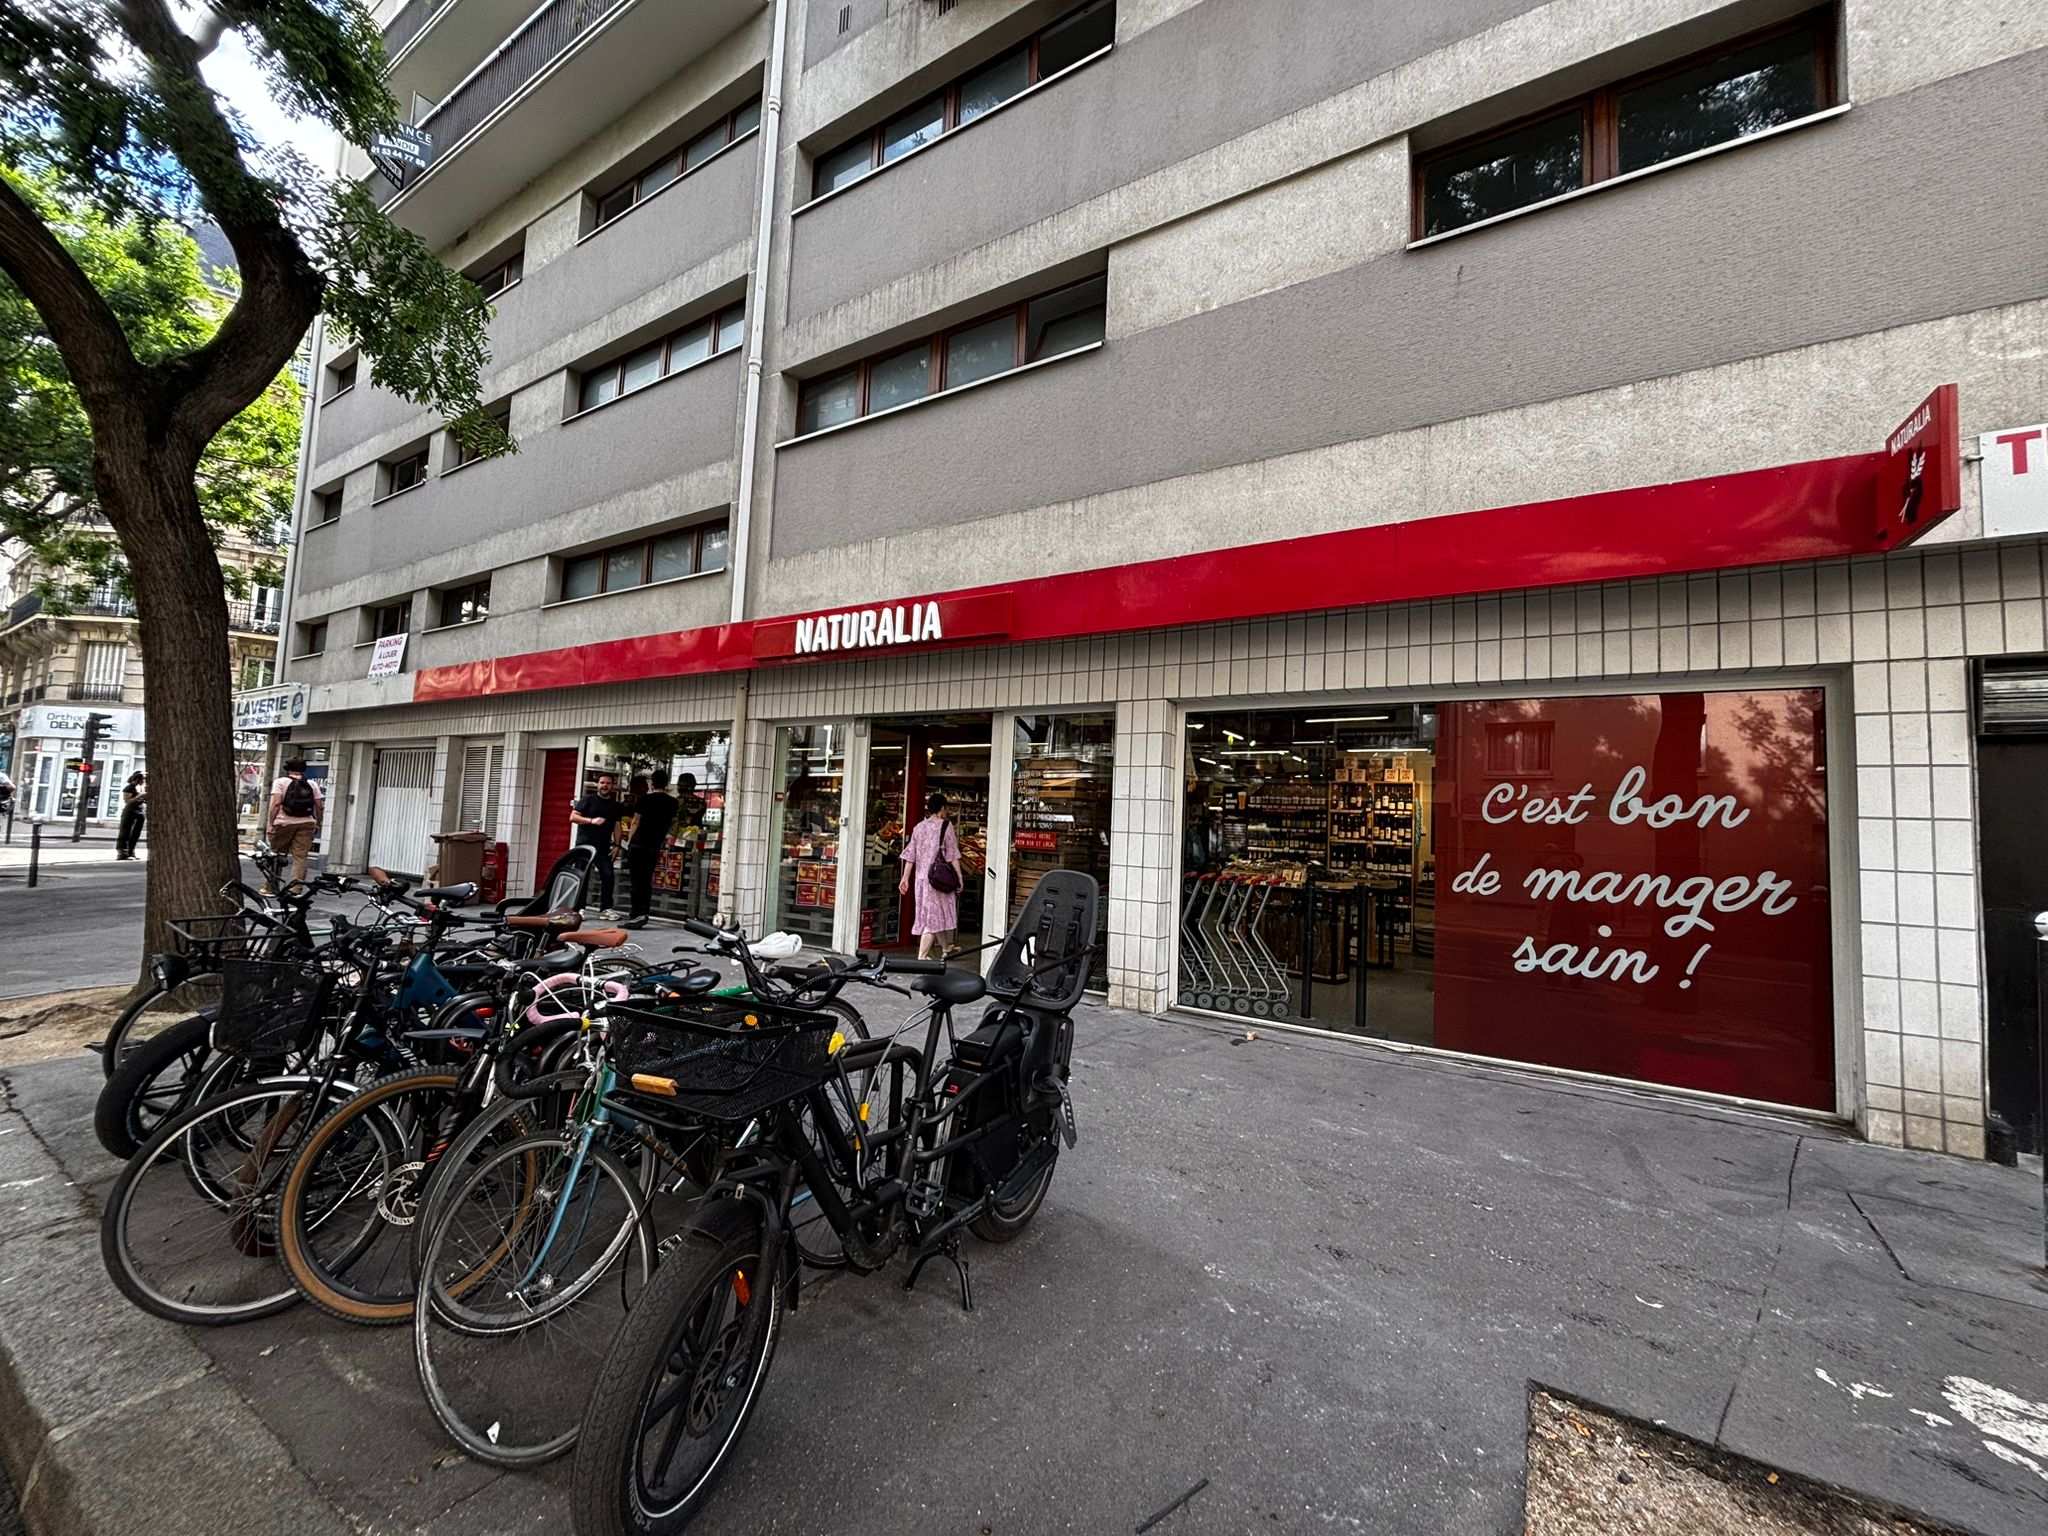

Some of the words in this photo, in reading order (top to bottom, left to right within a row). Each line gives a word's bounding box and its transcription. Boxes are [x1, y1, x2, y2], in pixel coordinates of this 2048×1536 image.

[371, 146, 380, 154] 01
[381, 148, 391, 156] 53
[392, 150, 403, 158] 44
[404, 154, 415, 162] 77
[1891, 404, 1931, 457] NATURALIA
[378, 637, 404, 649] PARKING
[795, 601, 942, 654] NATURALIA
[371, 660, 399, 671] AUTO-MOTO
[383, 650, 398, 659] LOUER
[236, 696, 289, 715] LAVERIE
[1481, 782, 1596, 825] C'est
[1608, 765, 1750, 829] bon
[1451, 853, 1502, 897] de
[1523, 867, 1798, 938] manger
[1512, 925, 1659, 985] sain
[1678, 943, 1712, 989] !
